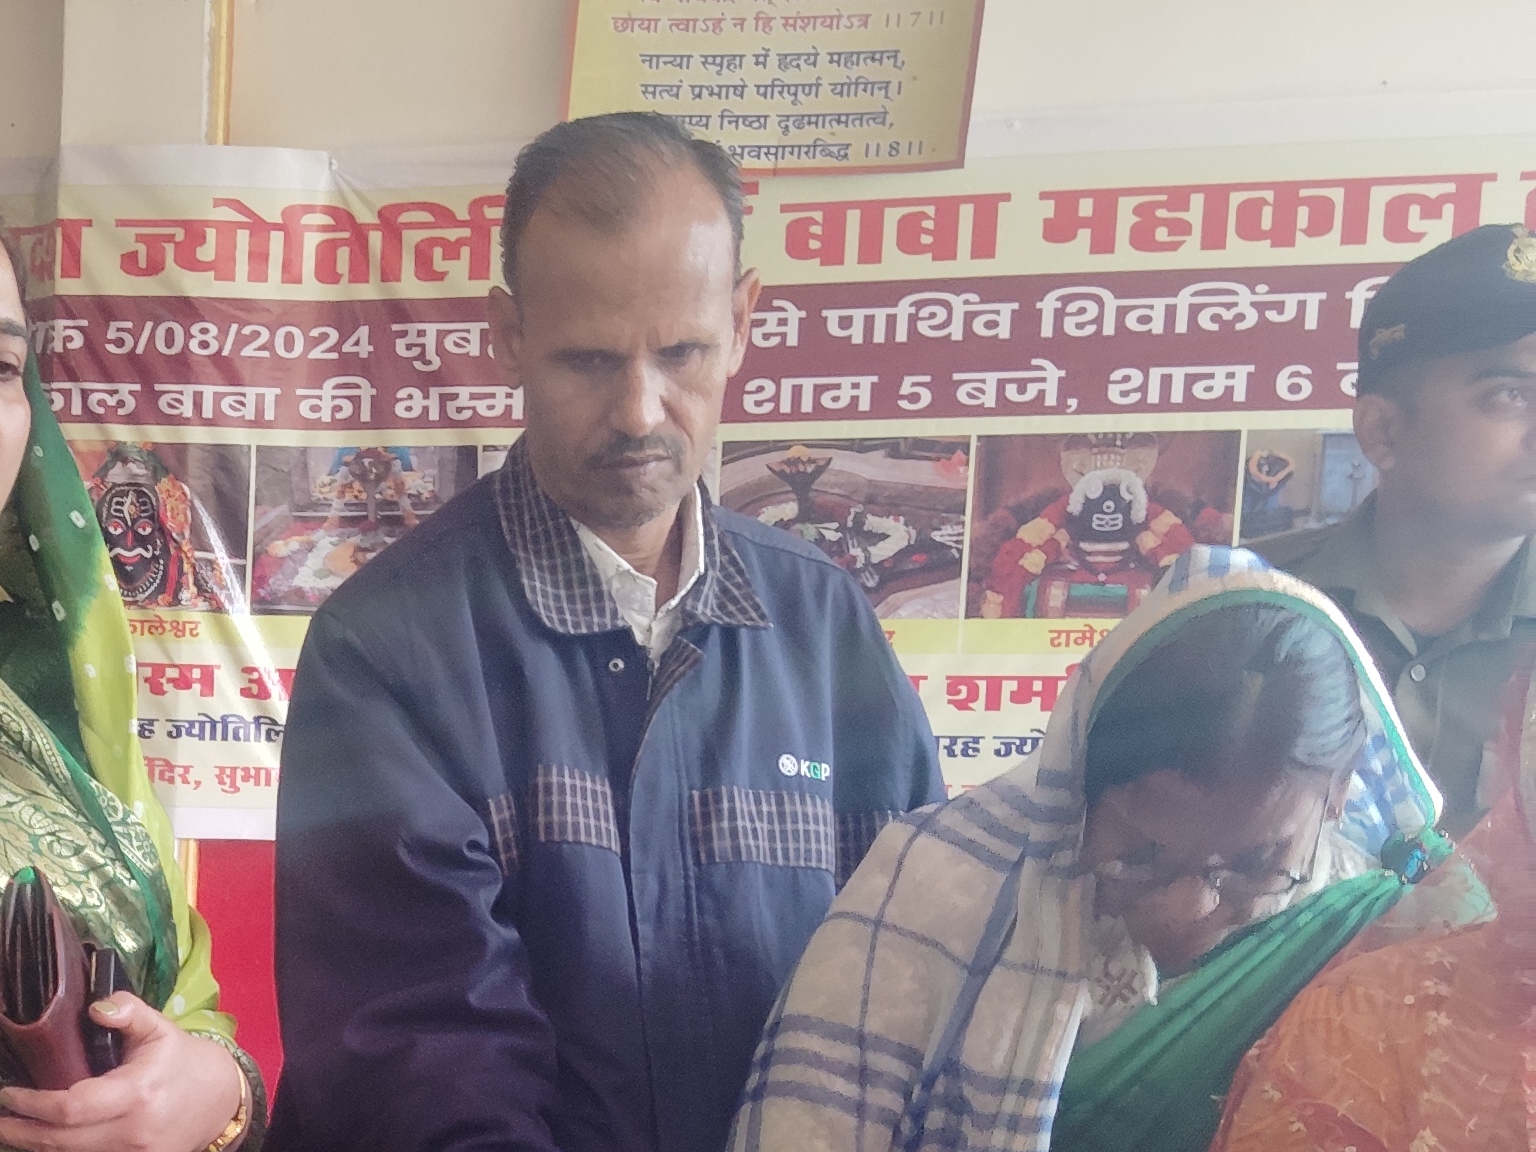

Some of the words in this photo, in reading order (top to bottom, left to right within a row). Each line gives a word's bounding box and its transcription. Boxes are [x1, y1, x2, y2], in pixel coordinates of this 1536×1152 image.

[731, 17, 748, 34] न
[753, 11, 777, 36] हि
[639, 53, 694, 71] नान्या
[775, 45, 821, 73] हृदये
[639, 79, 684, 101] सत्यं
[688, 78, 748, 101] प्रभाषे
[753, 76, 824, 106] परिपूर्ण
[779, 192, 1012, 266] बाबा
[1039, 172, 1498, 255] महाकाल
[104, 320, 375, 360] 5/08/2024
[390, 321, 495, 372] सुब
[750, 298, 807, 348] से
[821, 291, 1020, 345] पार्थिव
[1036, 281, 1327, 338] शिवलिंग
[153, 383, 282, 421] बाबा
[295, 375, 377, 423] की
[742, 374, 879, 415] शाम
[896, 374, 933, 411] 5
[951, 358, 1078, 414] बजे,
[1107, 364, 1255, 406] शाम
[1275, 363, 1314, 402] 6
